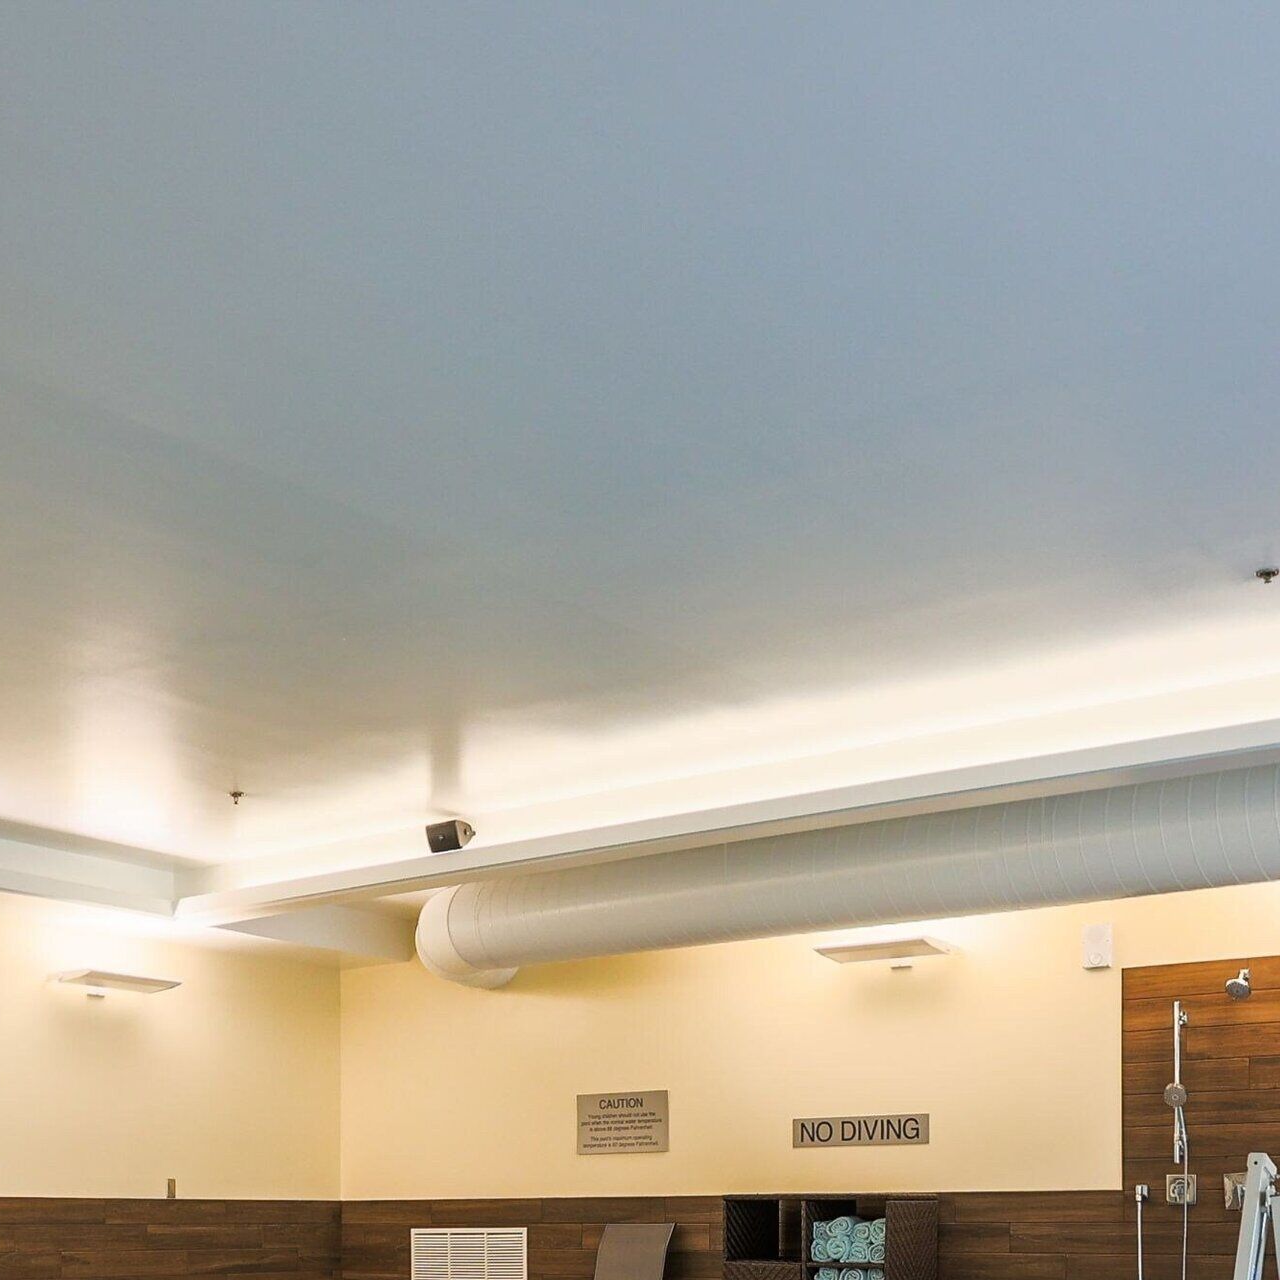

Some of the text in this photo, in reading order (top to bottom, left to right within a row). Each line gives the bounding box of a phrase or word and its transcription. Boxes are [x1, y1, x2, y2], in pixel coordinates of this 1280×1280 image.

[599, 1097, 644, 1110] CAUTION
[800, 1117, 920, 1143] NO DIVING
